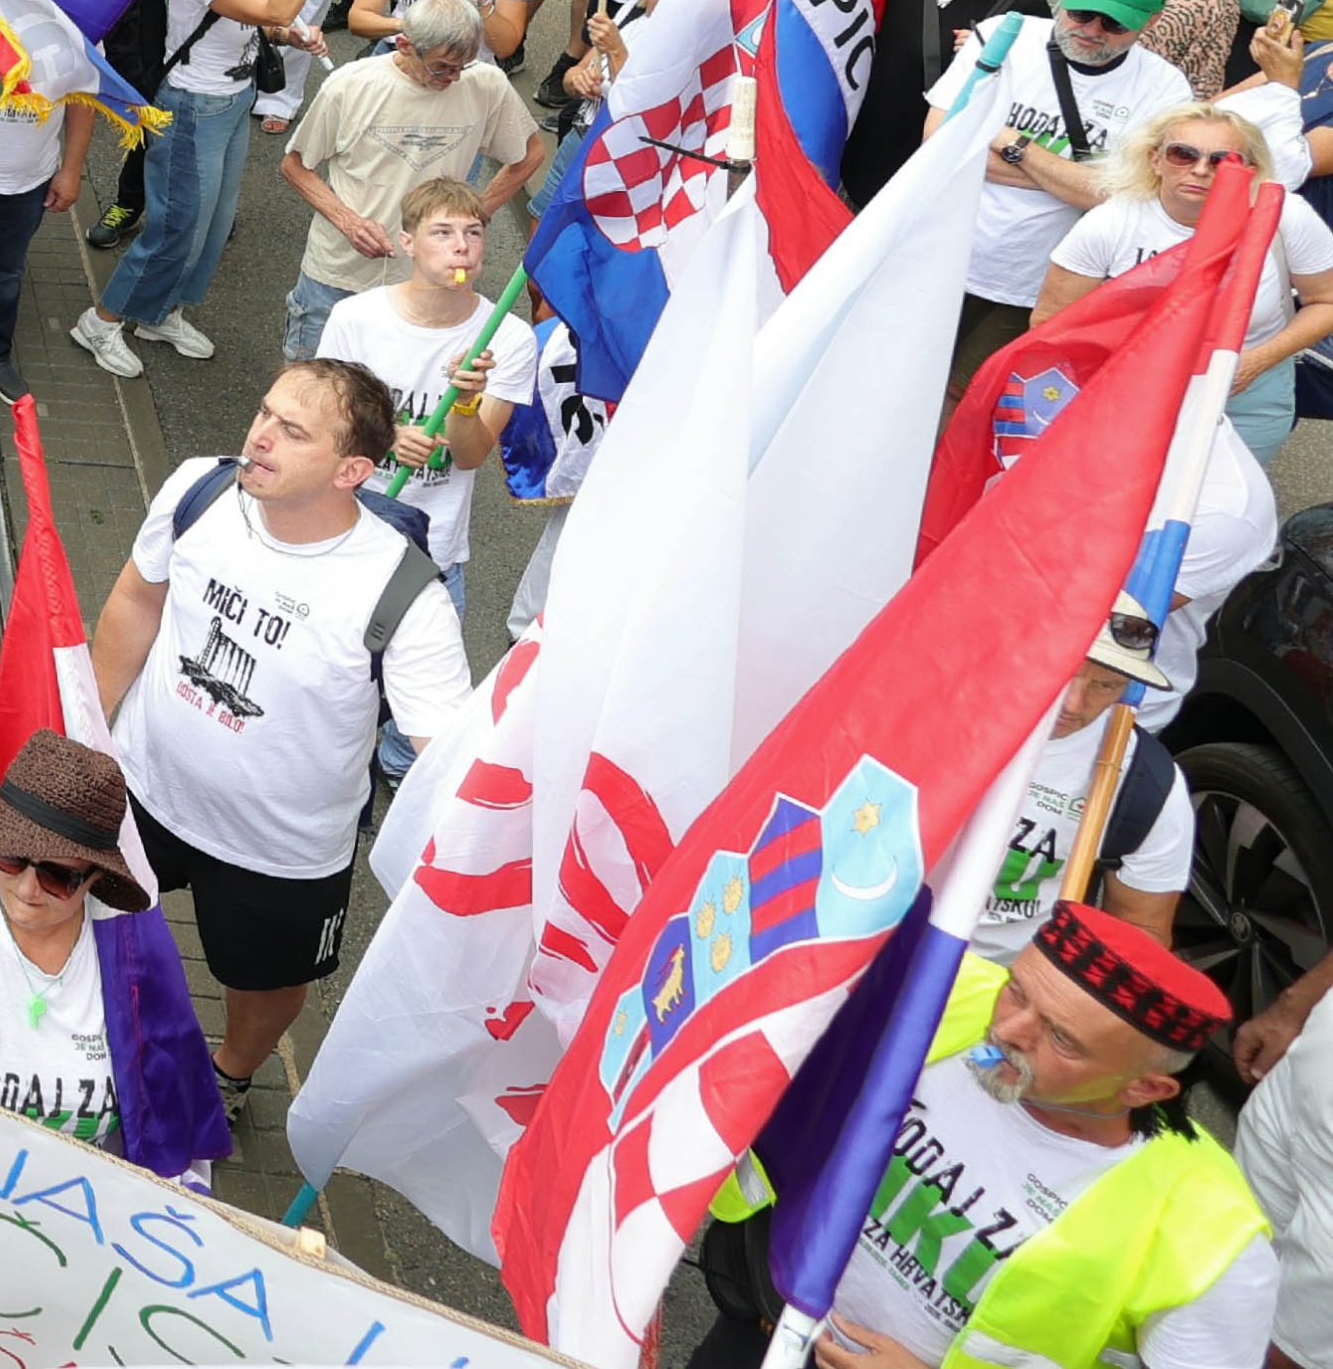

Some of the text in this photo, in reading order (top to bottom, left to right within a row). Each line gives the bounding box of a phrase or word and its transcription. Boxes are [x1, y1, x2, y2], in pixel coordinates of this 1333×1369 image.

[203, 577, 292, 651] MIČI TO!
[1009, 816, 1057, 865] ZA
[77, 1075, 119, 1121] ZA
